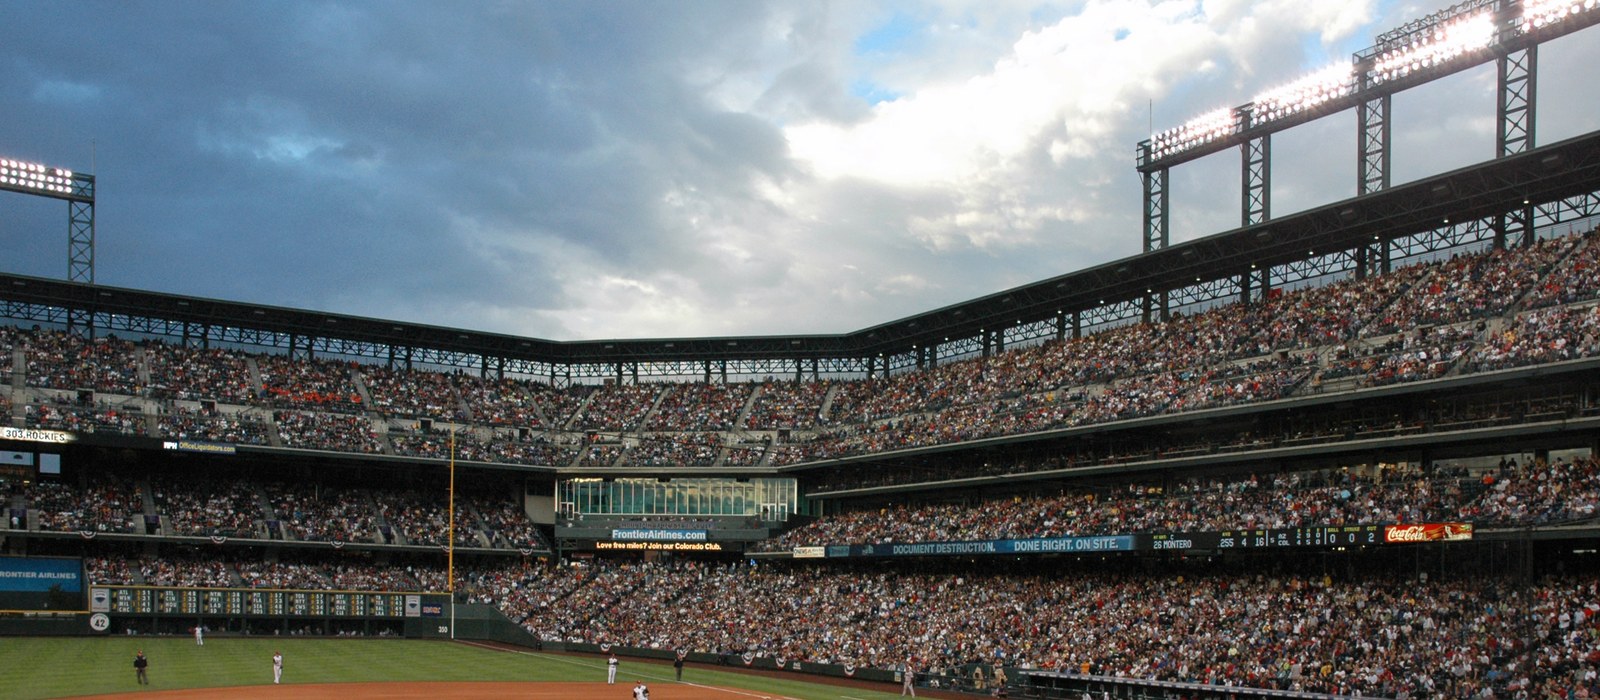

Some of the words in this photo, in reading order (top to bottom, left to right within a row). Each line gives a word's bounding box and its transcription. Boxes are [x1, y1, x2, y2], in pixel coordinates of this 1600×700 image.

[612, 530, 706, 539] FrontierAirlines.com
[1330, 534, 1336, 543] 0
[1349, 533, 1354, 542] 0
[1368, 533, 1374, 542] 2
[893, 544, 936, 554] DOCUMENT
[936, 542, 995, 553] DESTRUCTION.
[1014, 541, 1039, 551] DONE
[1043, 540, 1073, 551] RIGHT.
[1076, 540, 1091, 550] ON
[1092, 538, 1118, 549] SITE.
[1153, 541, 1162, 549] 26
[1163, 540, 1192, 548] MONTERO
[1242, 538, 1246, 546] 4
[1255, 538, 1264, 546] 16
[95, 619, 105, 628] 42
